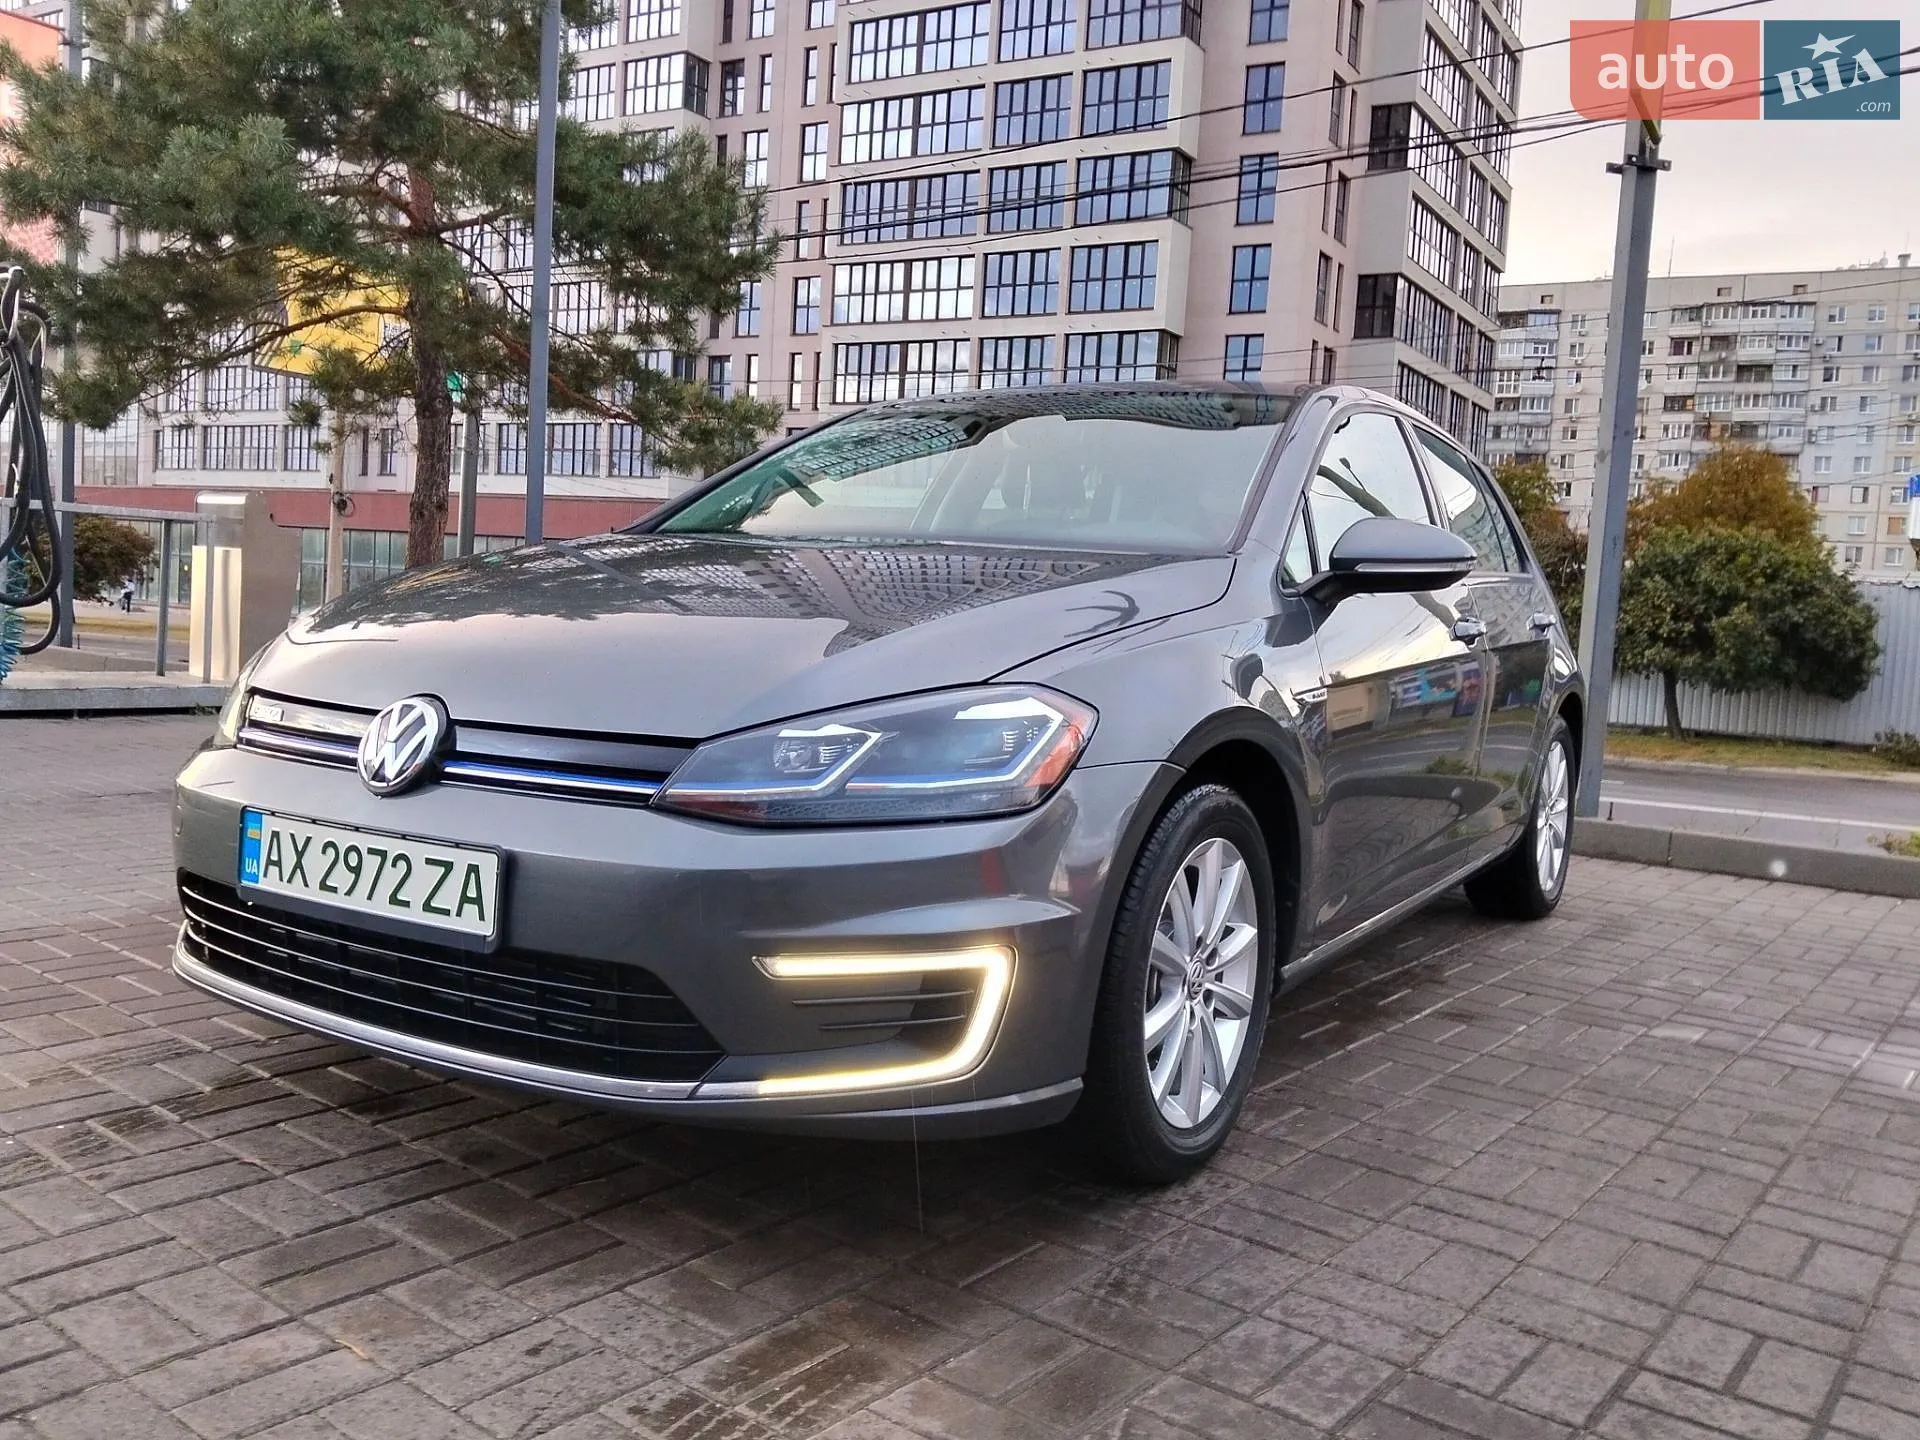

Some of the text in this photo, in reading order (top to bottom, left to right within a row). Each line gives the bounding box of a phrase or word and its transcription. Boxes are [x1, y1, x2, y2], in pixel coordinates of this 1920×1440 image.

[245, 857, 259, 876] UA
[263, 829, 486, 922] AX 2972 ZA
